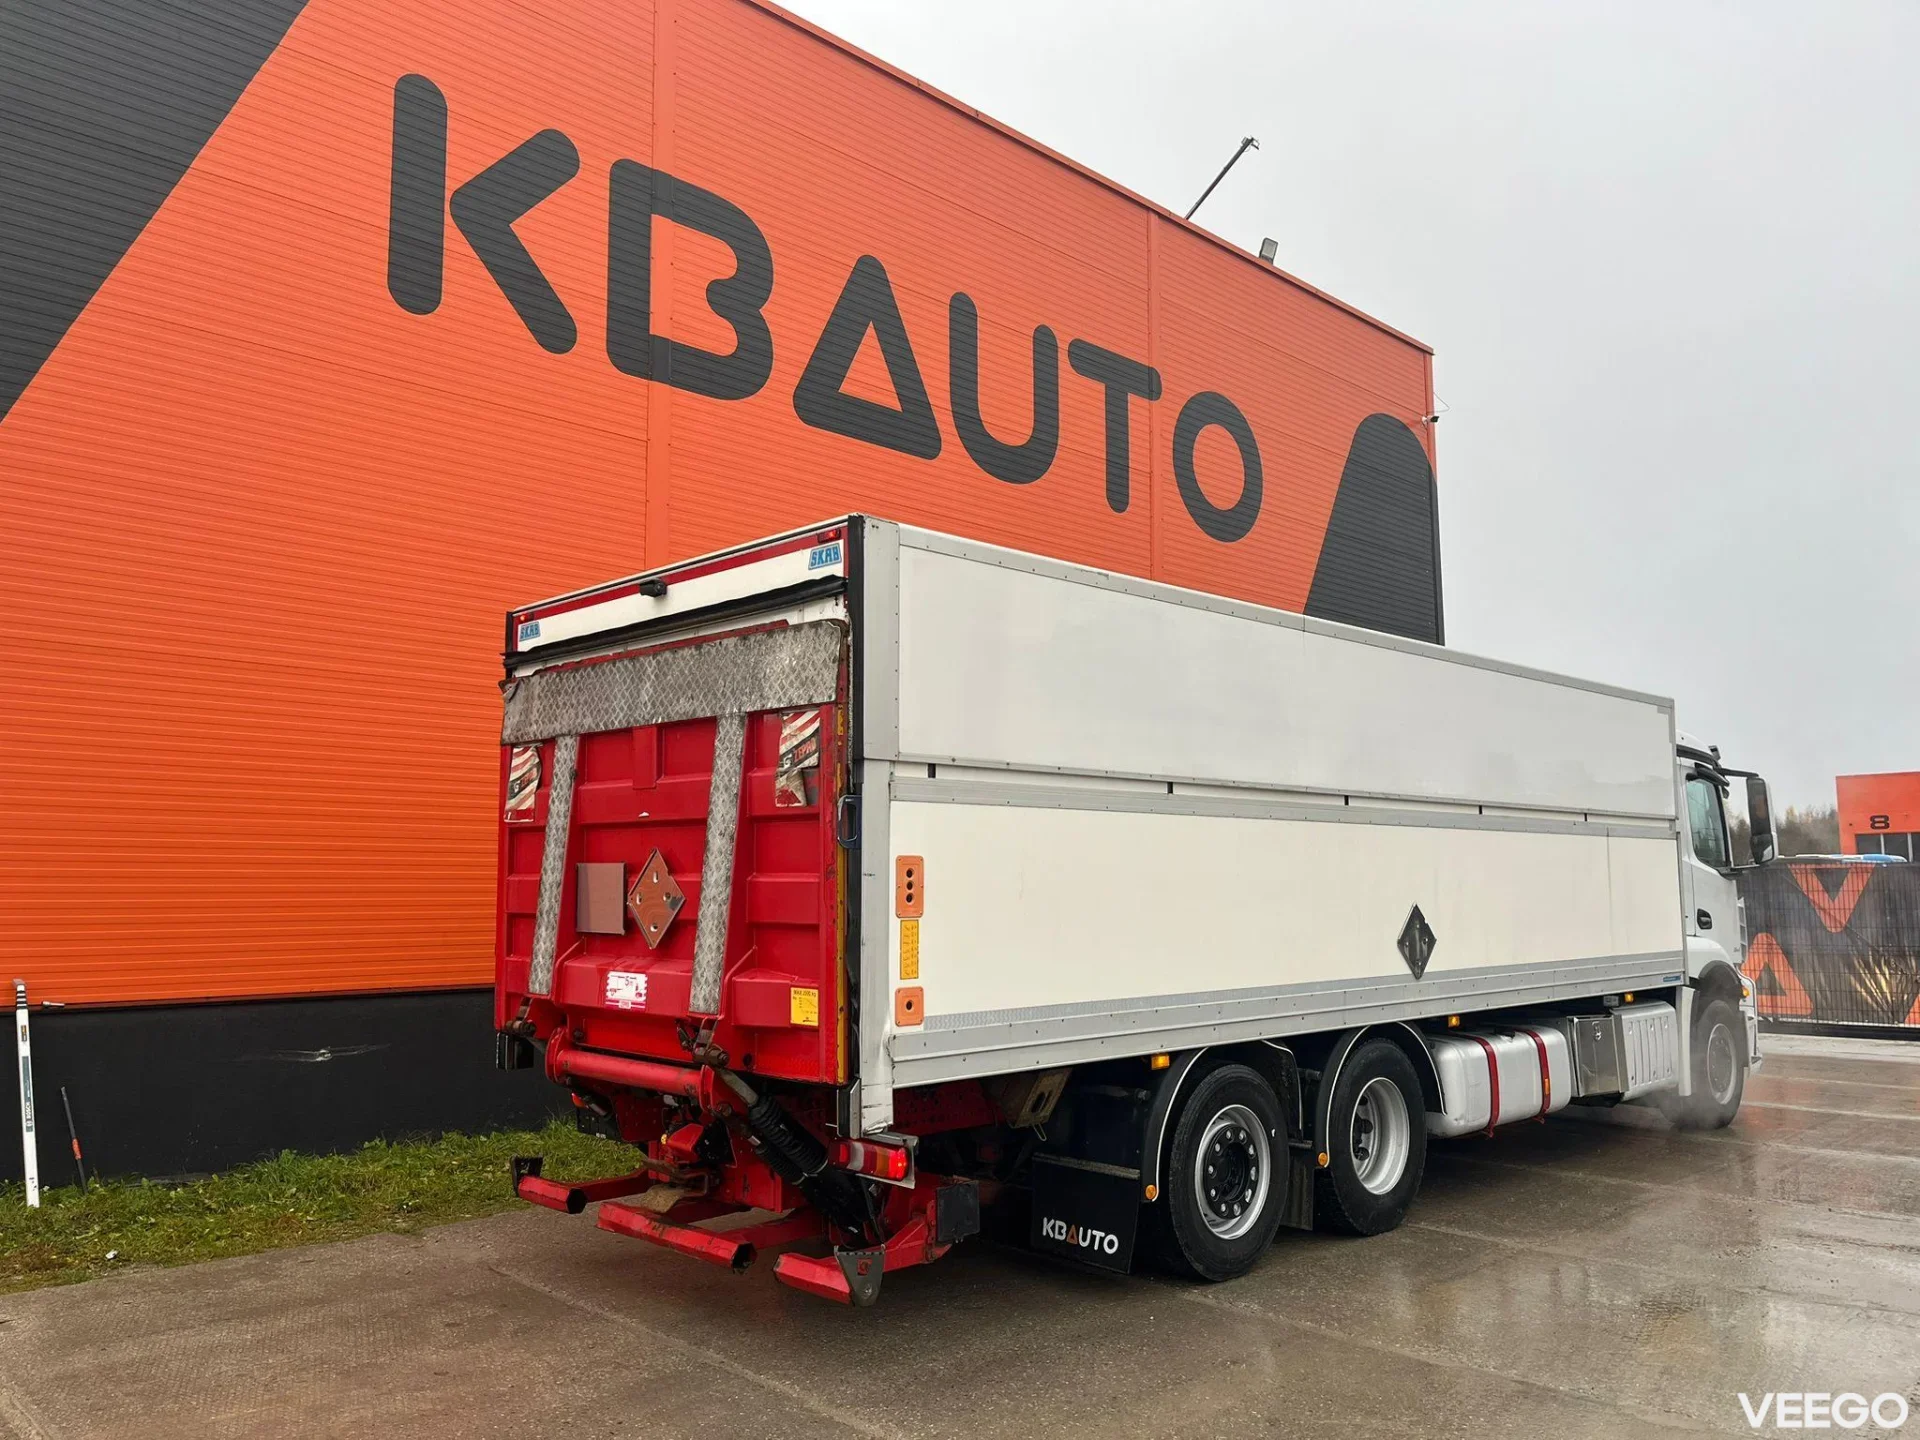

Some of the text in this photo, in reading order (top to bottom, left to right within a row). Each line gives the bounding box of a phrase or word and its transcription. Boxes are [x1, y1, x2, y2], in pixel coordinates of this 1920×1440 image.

[387, 73, 1264, 543] KBAUTO
[810, 545, 840, 567] SKAB
[520, 623, 540, 640] SKAB
[1869, 815, 1890, 830] 8
[25, 1101, 33, 1119] BOSCH
[1042, 1217, 1119, 1254] KBAUTO
